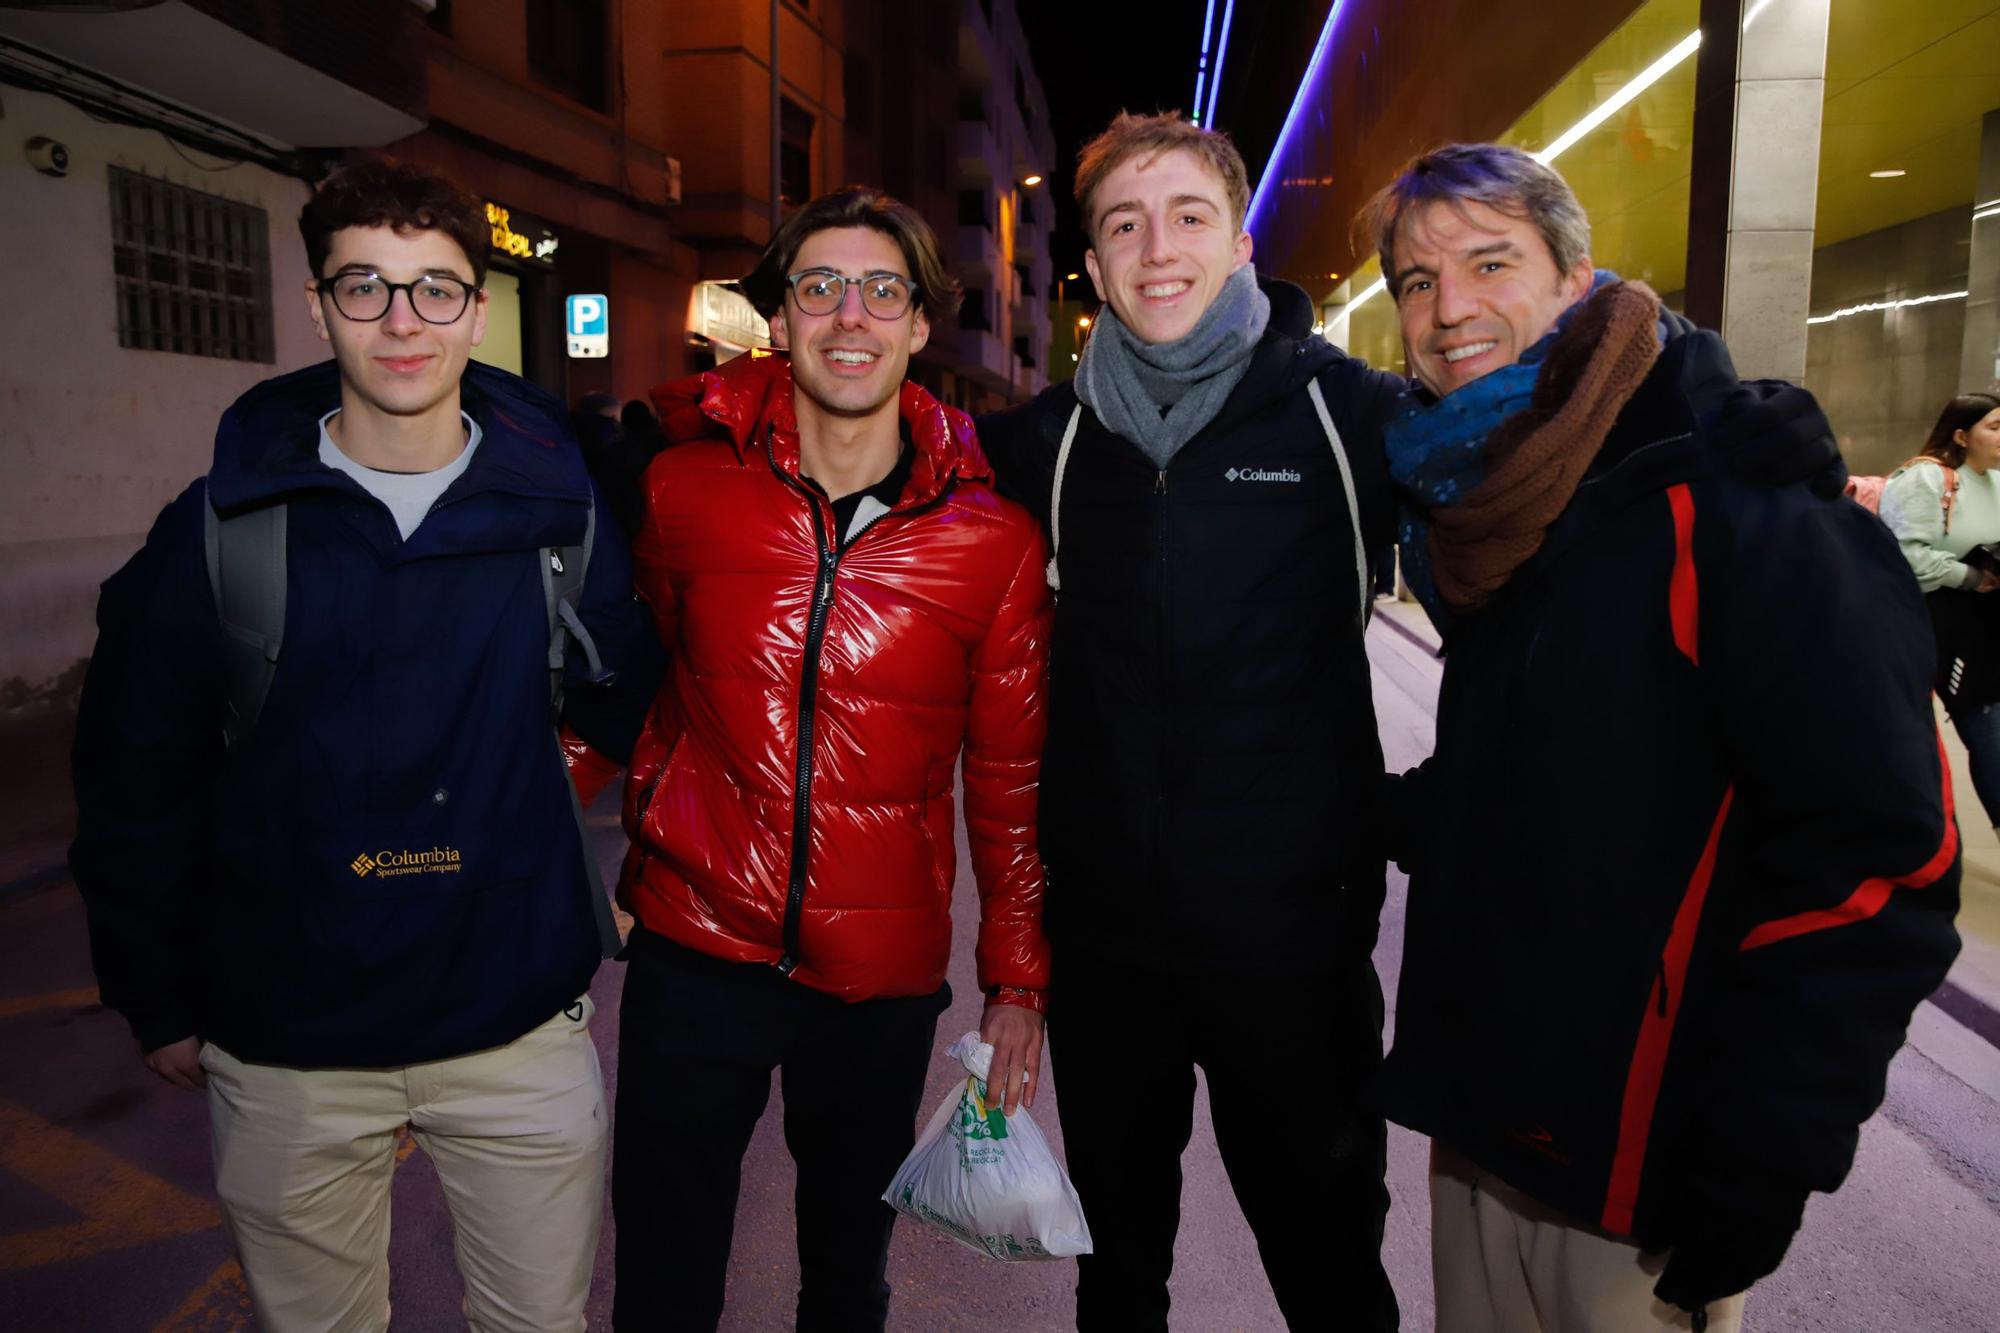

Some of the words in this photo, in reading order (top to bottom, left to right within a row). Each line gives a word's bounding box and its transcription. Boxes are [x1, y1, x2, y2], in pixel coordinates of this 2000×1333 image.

[573, 298, 601, 335] P
[1240, 468, 1301, 482] Columbia
[377, 846, 461, 866] Columbia
[377, 867, 422, 878] Sportswear
[423, 863, 461, 873] Company
